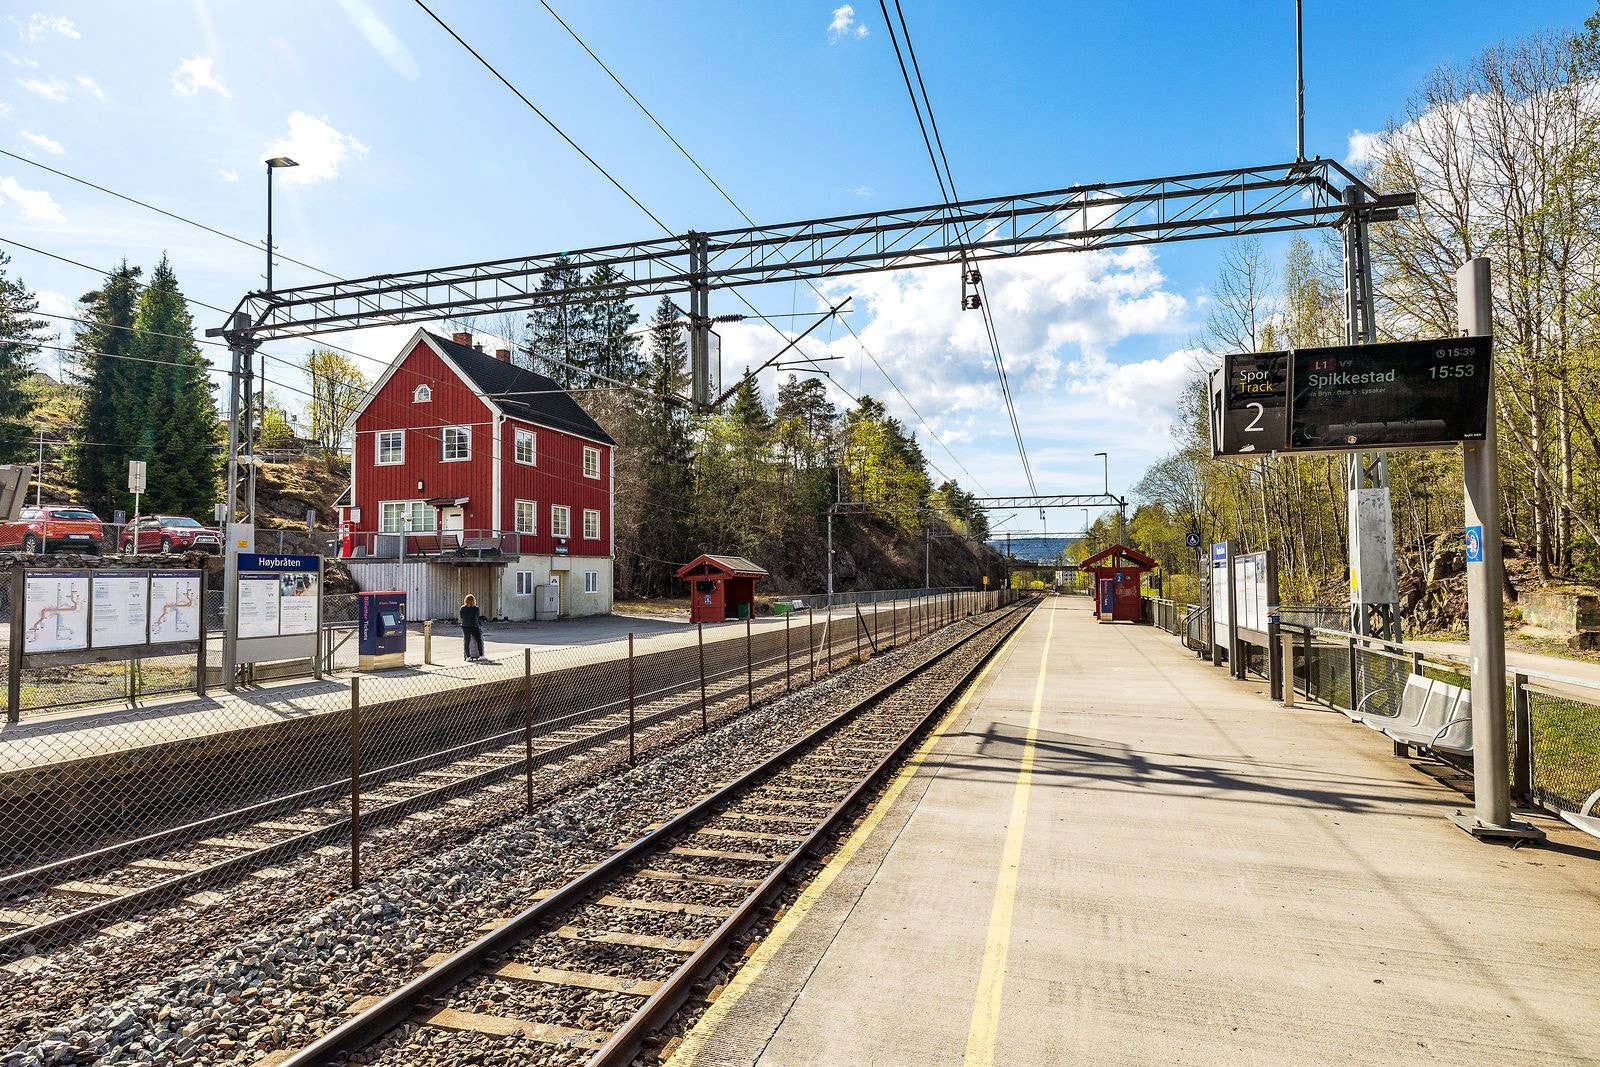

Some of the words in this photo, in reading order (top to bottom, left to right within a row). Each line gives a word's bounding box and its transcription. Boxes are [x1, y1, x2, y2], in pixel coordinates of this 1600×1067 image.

[1447, 347, 1476, 357] 15:39
[1315, 361, 1328, 370] L1
[1240, 369, 1269, 383] Spor
[1308, 369, 1396, 389] Spikkestad
[1428, 364, 1475, 379] 15:53
[1240, 381, 1273, 393] Track
[1318, 390, 1332, 398] Bryn
[1336, 388, 1351, 396] Oslo
[1361, 387, 1387, 395] Lysaker
[1244, 402, 1264, 432] 2
[258, 557, 302, 568] Høybråten
